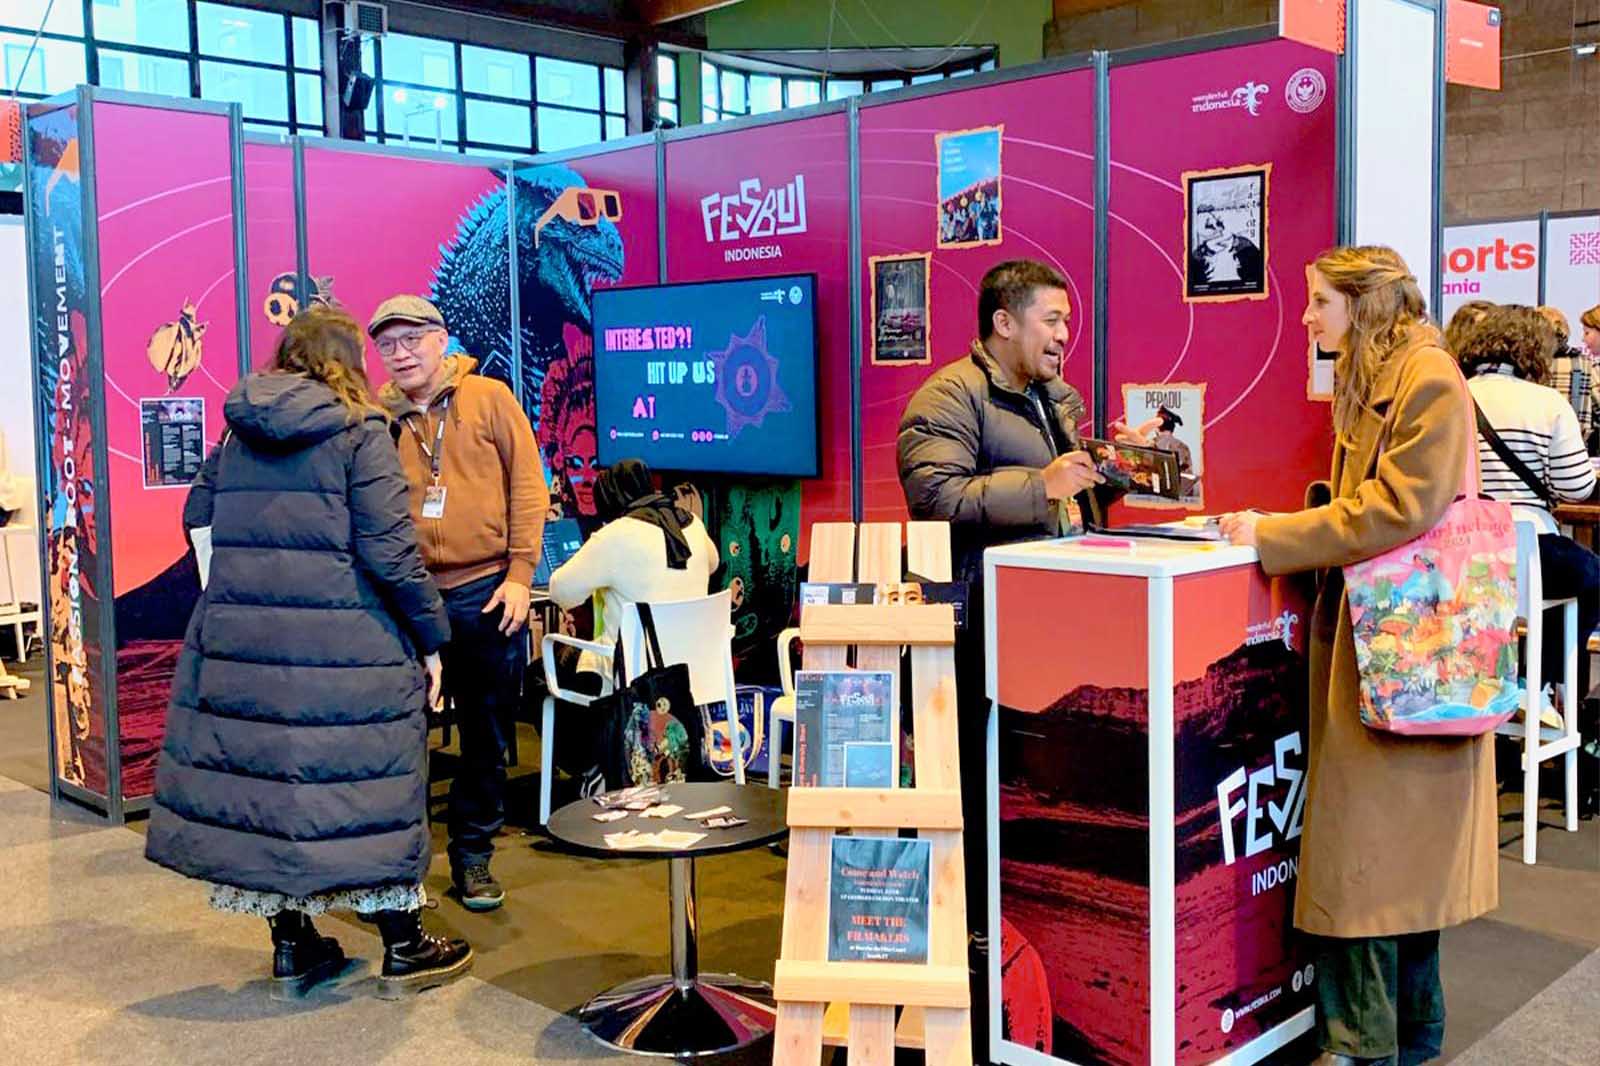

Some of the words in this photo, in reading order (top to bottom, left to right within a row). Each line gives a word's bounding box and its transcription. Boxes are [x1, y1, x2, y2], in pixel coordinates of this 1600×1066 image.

[725, 246, 782, 263] INDONESIA
[54, 225, 73, 411] MOVEMENT
[648, 361, 666, 385] HIT
[668, 361, 688, 385] UP
[692, 360, 715, 385] US
[632, 396, 656, 419] AT
[1145, 390, 1182, 409] PEPADU
